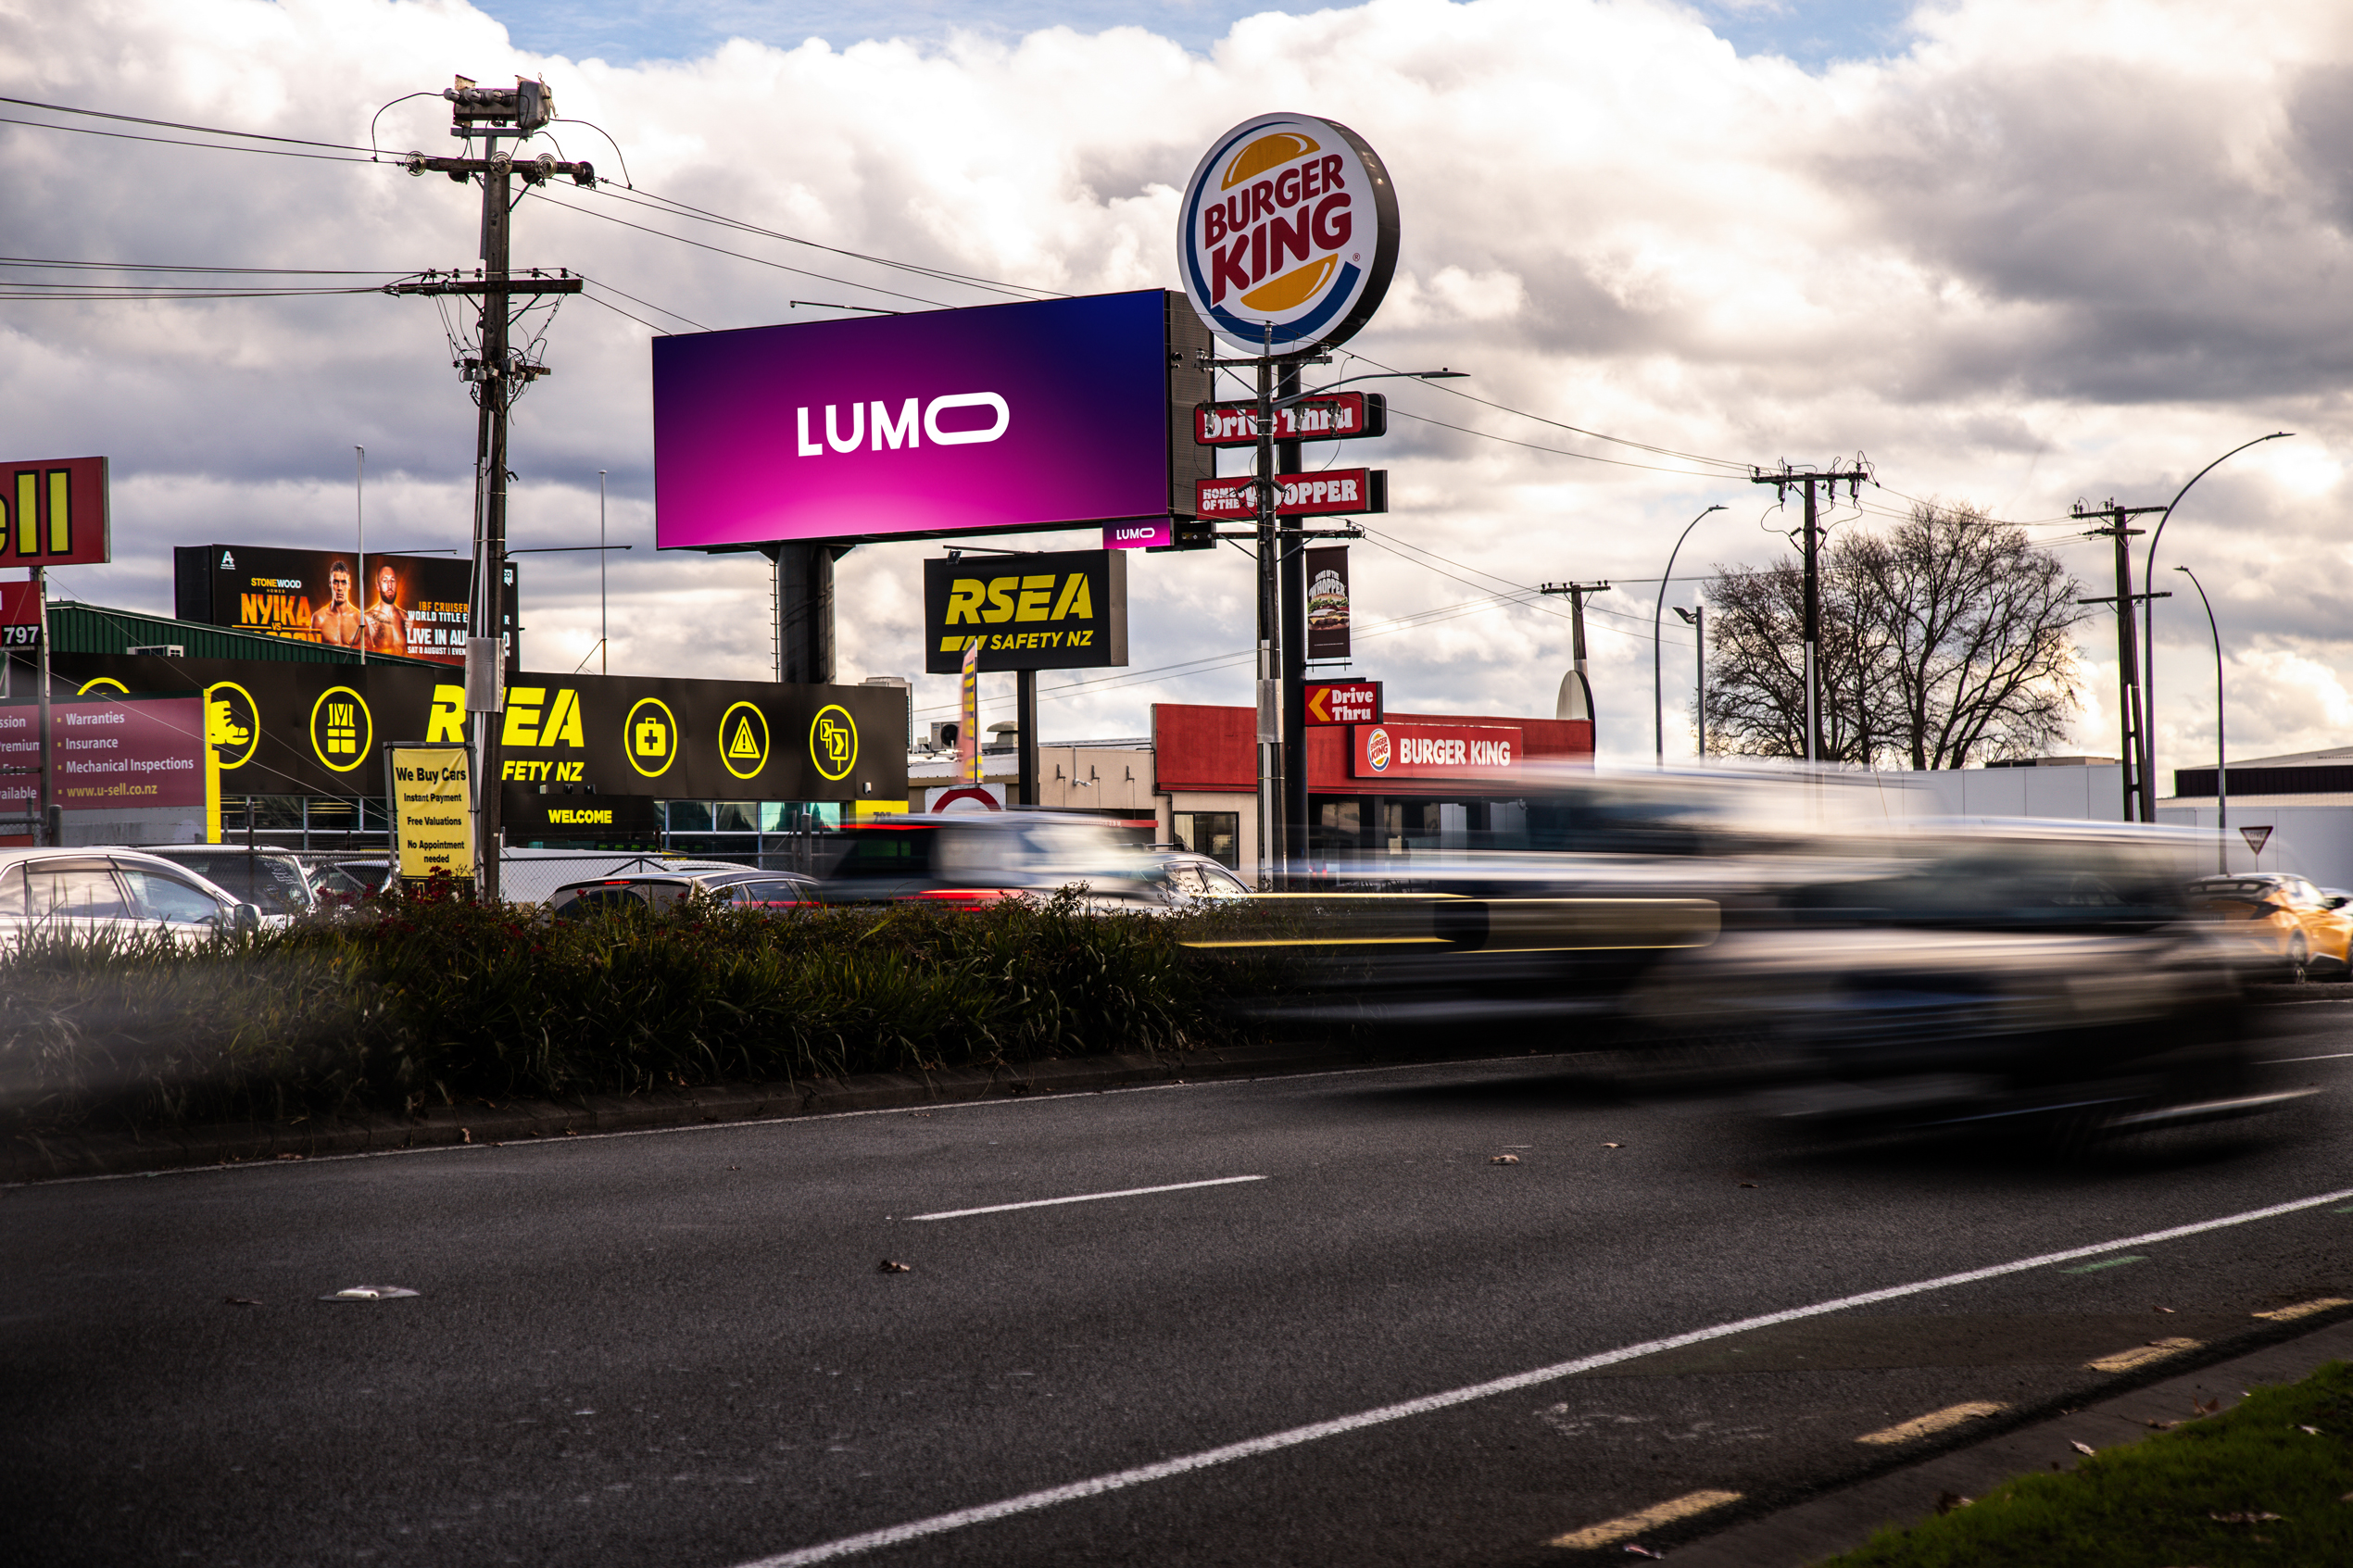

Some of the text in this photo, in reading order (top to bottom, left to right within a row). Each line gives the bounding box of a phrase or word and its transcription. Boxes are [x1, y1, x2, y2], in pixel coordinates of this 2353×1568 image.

[1204, 154, 1345, 250] BURGER
[1212, 193, 1352, 306] KING
[797, 392, 1010, 457] LUMO
[1239, 479, 1358, 508] WOPPER
[1202, 498, 1240, 510] OF THE
[1116, 527, 1155, 540] LUMO
[251, 577, 302, 589] STONEWOOD
[1308, 578, 1345, 600] WHOPPER
[945, 572, 1094, 625] RSEA
[241, 593, 312, 626] NYIKA
[419, 601, 469, 613] IBF CRUISER
[408, 610, 436, 621] WORLD
[438, 612, 461, 622] TITLE
[271, 621, 282, 631] VS
[4, 626, 39, 645] 797
[406, 628, 432, 645] LIVE
[434, 629, 447, 646] IN
[990, 630, 1094, 650] SAFETY NZ
[1332, 687, 1374, 704] Drive
[66, 711, 125, 725] Warranties
[426, 684, 585, 747] REA
[1332, 706, 1371, 721] Thru
[66, 737, 119, 749] Insurance
[1371, 744, 1389, 761] KING
[1400, 738, 1511, 767] BURGER KING
[66, 757, 194, 773] Mechanical Inspections
[501, 760, 585, 782] FETY NZ
[396, 767, 466, 784] We Buy Cars
[0, 786, 37, 800] ailable
[67, 783, 157, 797] www.u-sell.co.nz
[404, 793, 461, 804] Instant Payment
[407, 816, 461, 826] Free Valuations
[548, 809, 612, 824] WELCOME
[408, 839, 465, 851] No Appointment
[423, 854, 449, 863] needed
